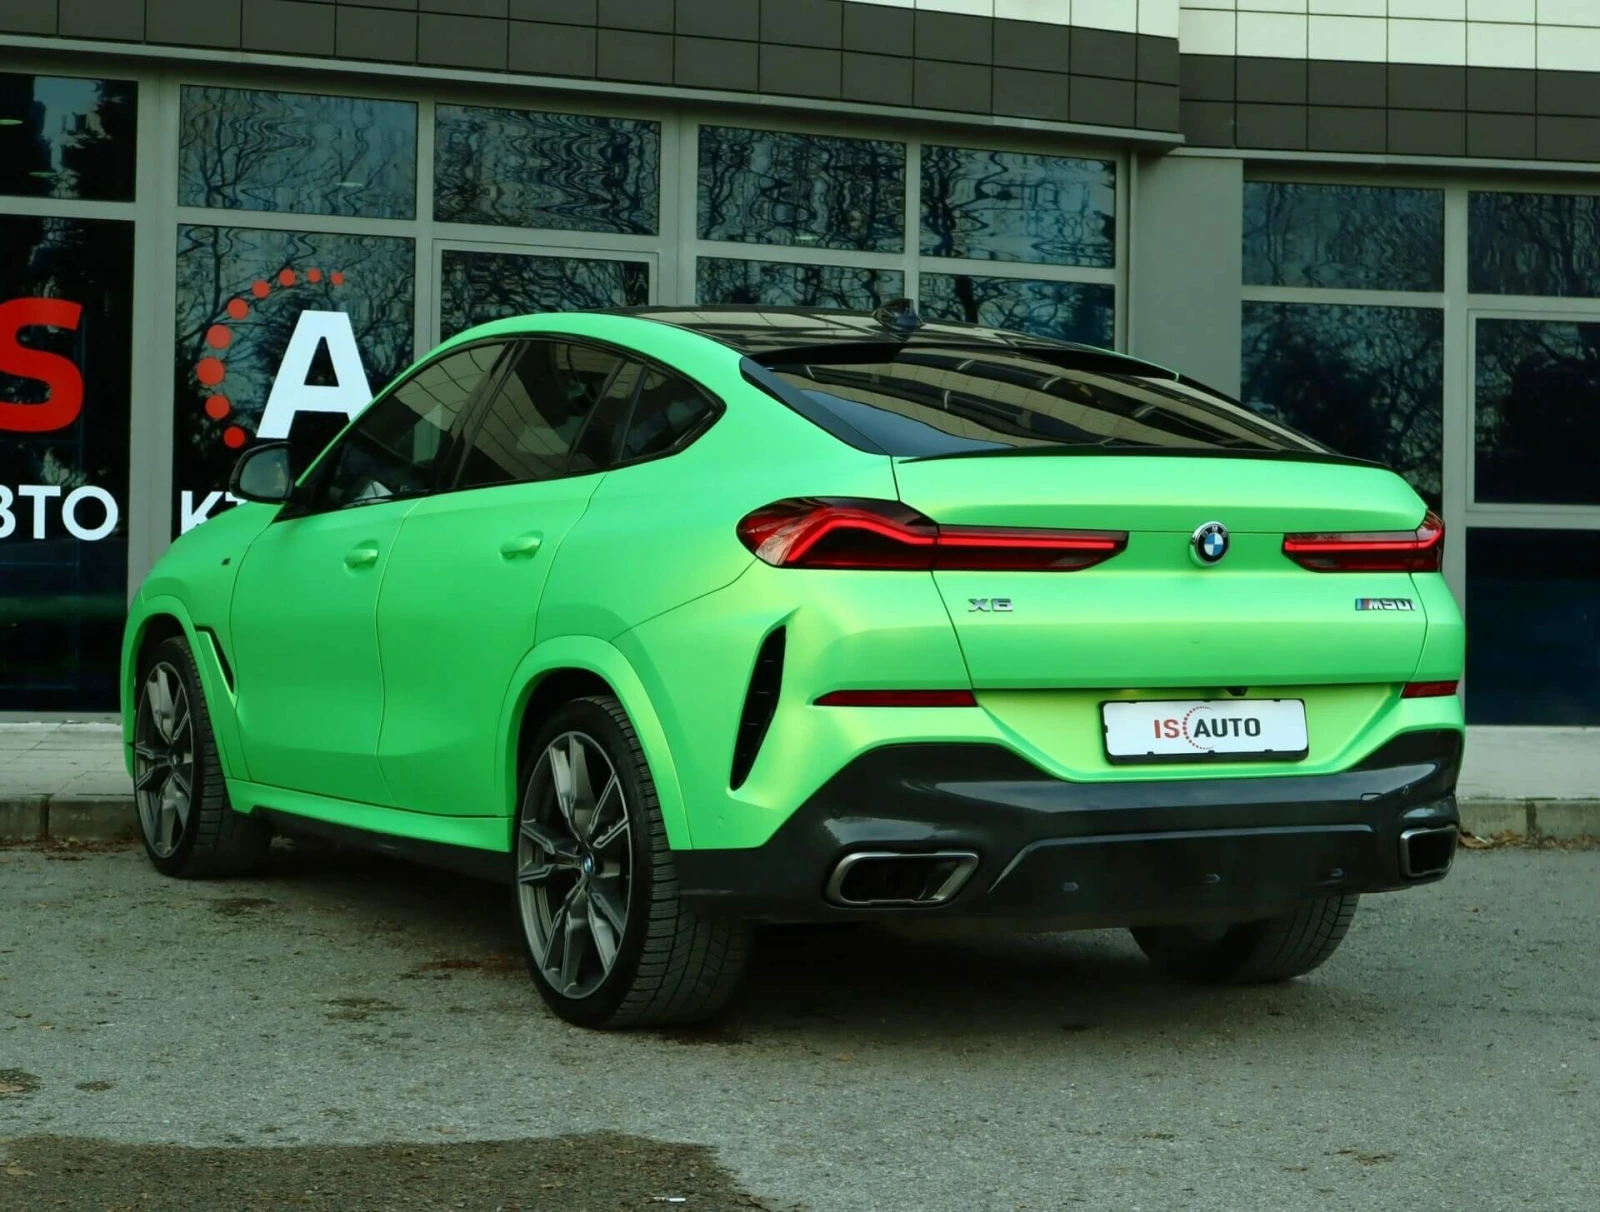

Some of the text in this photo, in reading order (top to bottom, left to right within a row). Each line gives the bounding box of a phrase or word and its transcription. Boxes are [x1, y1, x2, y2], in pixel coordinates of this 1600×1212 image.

[967, 598, 1013, 612] X6
[1154, 718, 1261, 739] IS AUTO
